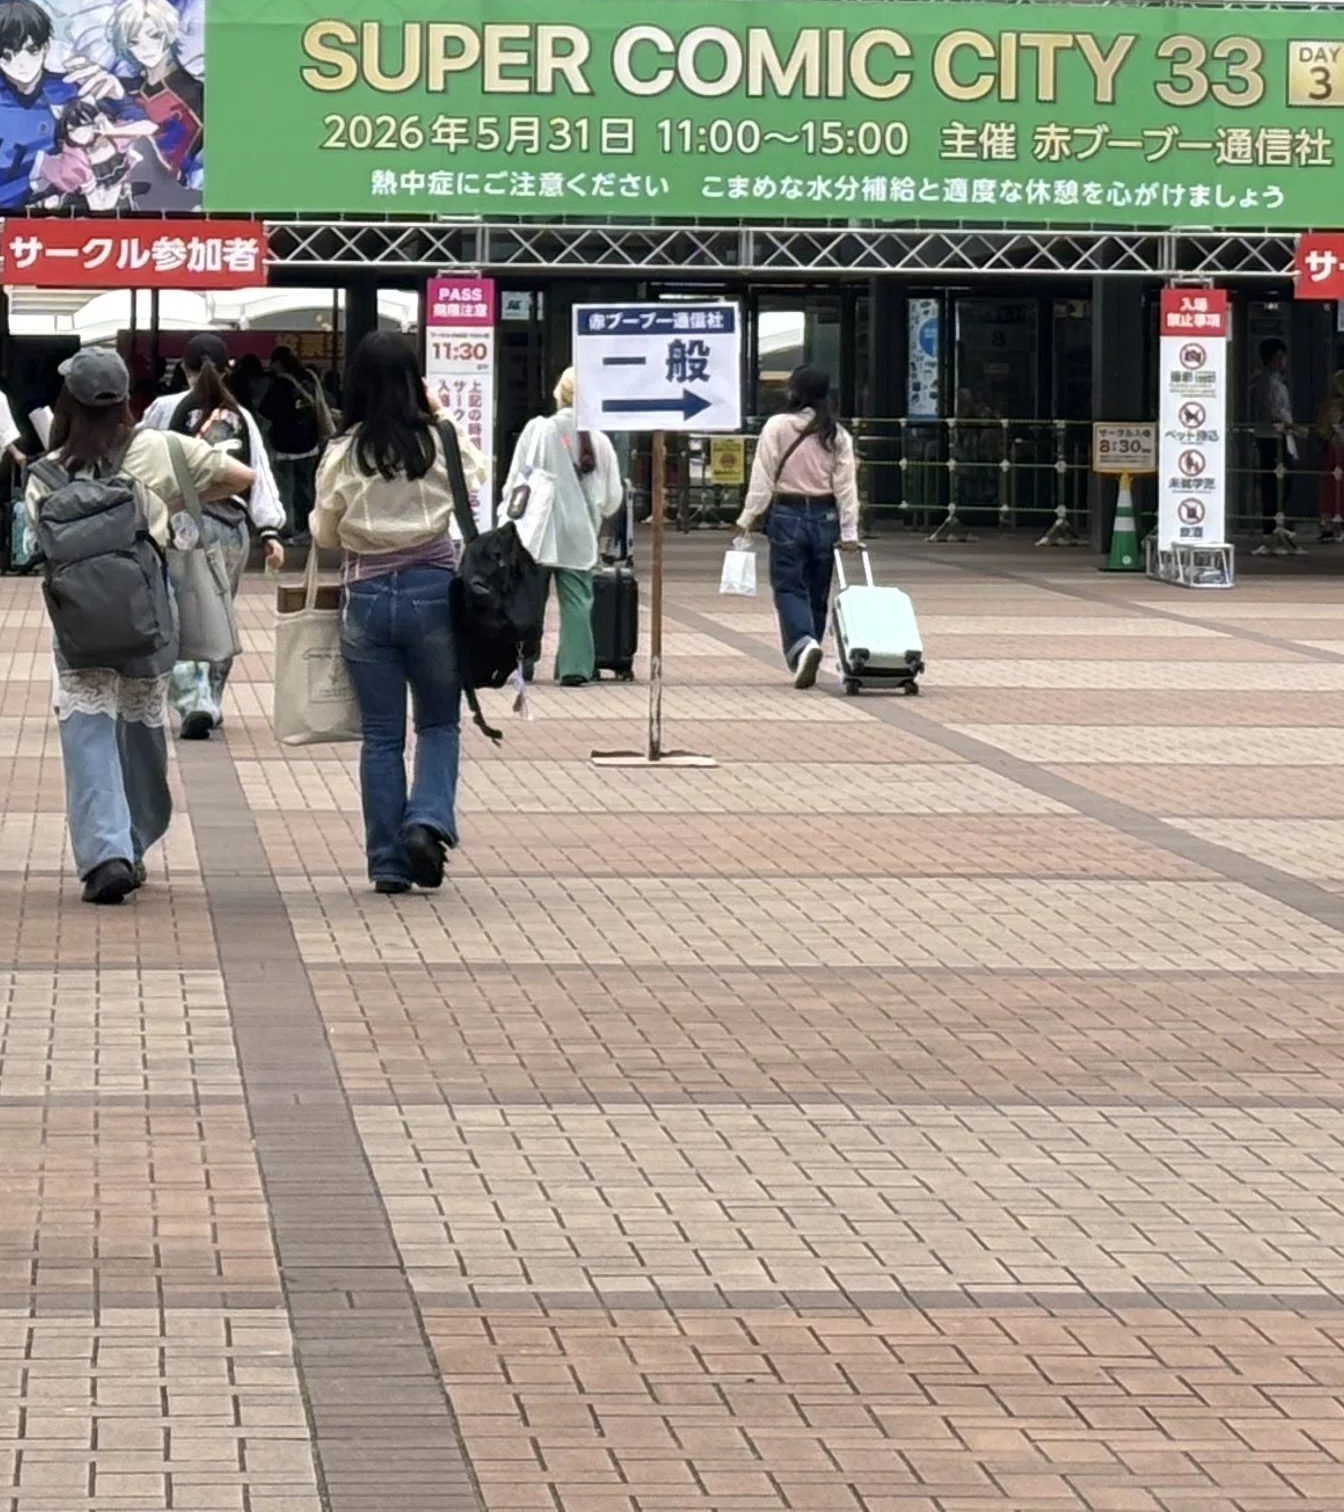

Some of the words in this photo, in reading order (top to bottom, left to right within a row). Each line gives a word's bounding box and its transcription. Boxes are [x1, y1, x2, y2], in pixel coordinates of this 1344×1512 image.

[300, 19, 594, 95] SUPER
[612, 24, 913, 100] COMIC
[932, 29, 1136, 104] CITY
[1154, 34, 1266, 108] 33
[1298, 46, 1341, 64] DAY
[1308, 66, 1334, 100] 3
[939, 121, 1017, 162] 主催
[1032, 122, 1335, 167] 赤ブーブー通信社
[370, 169, 669, 198] 熱中症にご注意ください
[700, 174, 1286, 208] こまめな水分補給と適度な休憩を心がけましょう
[8, 234, 259, 273] サークル参加者
[438, 287, 483, 301] PASS
[588, 311, 724, 331] 赤ブーブー通信社
[432, 342, 488, 360] 11:30
[602, 338, 711, 383] 一般
